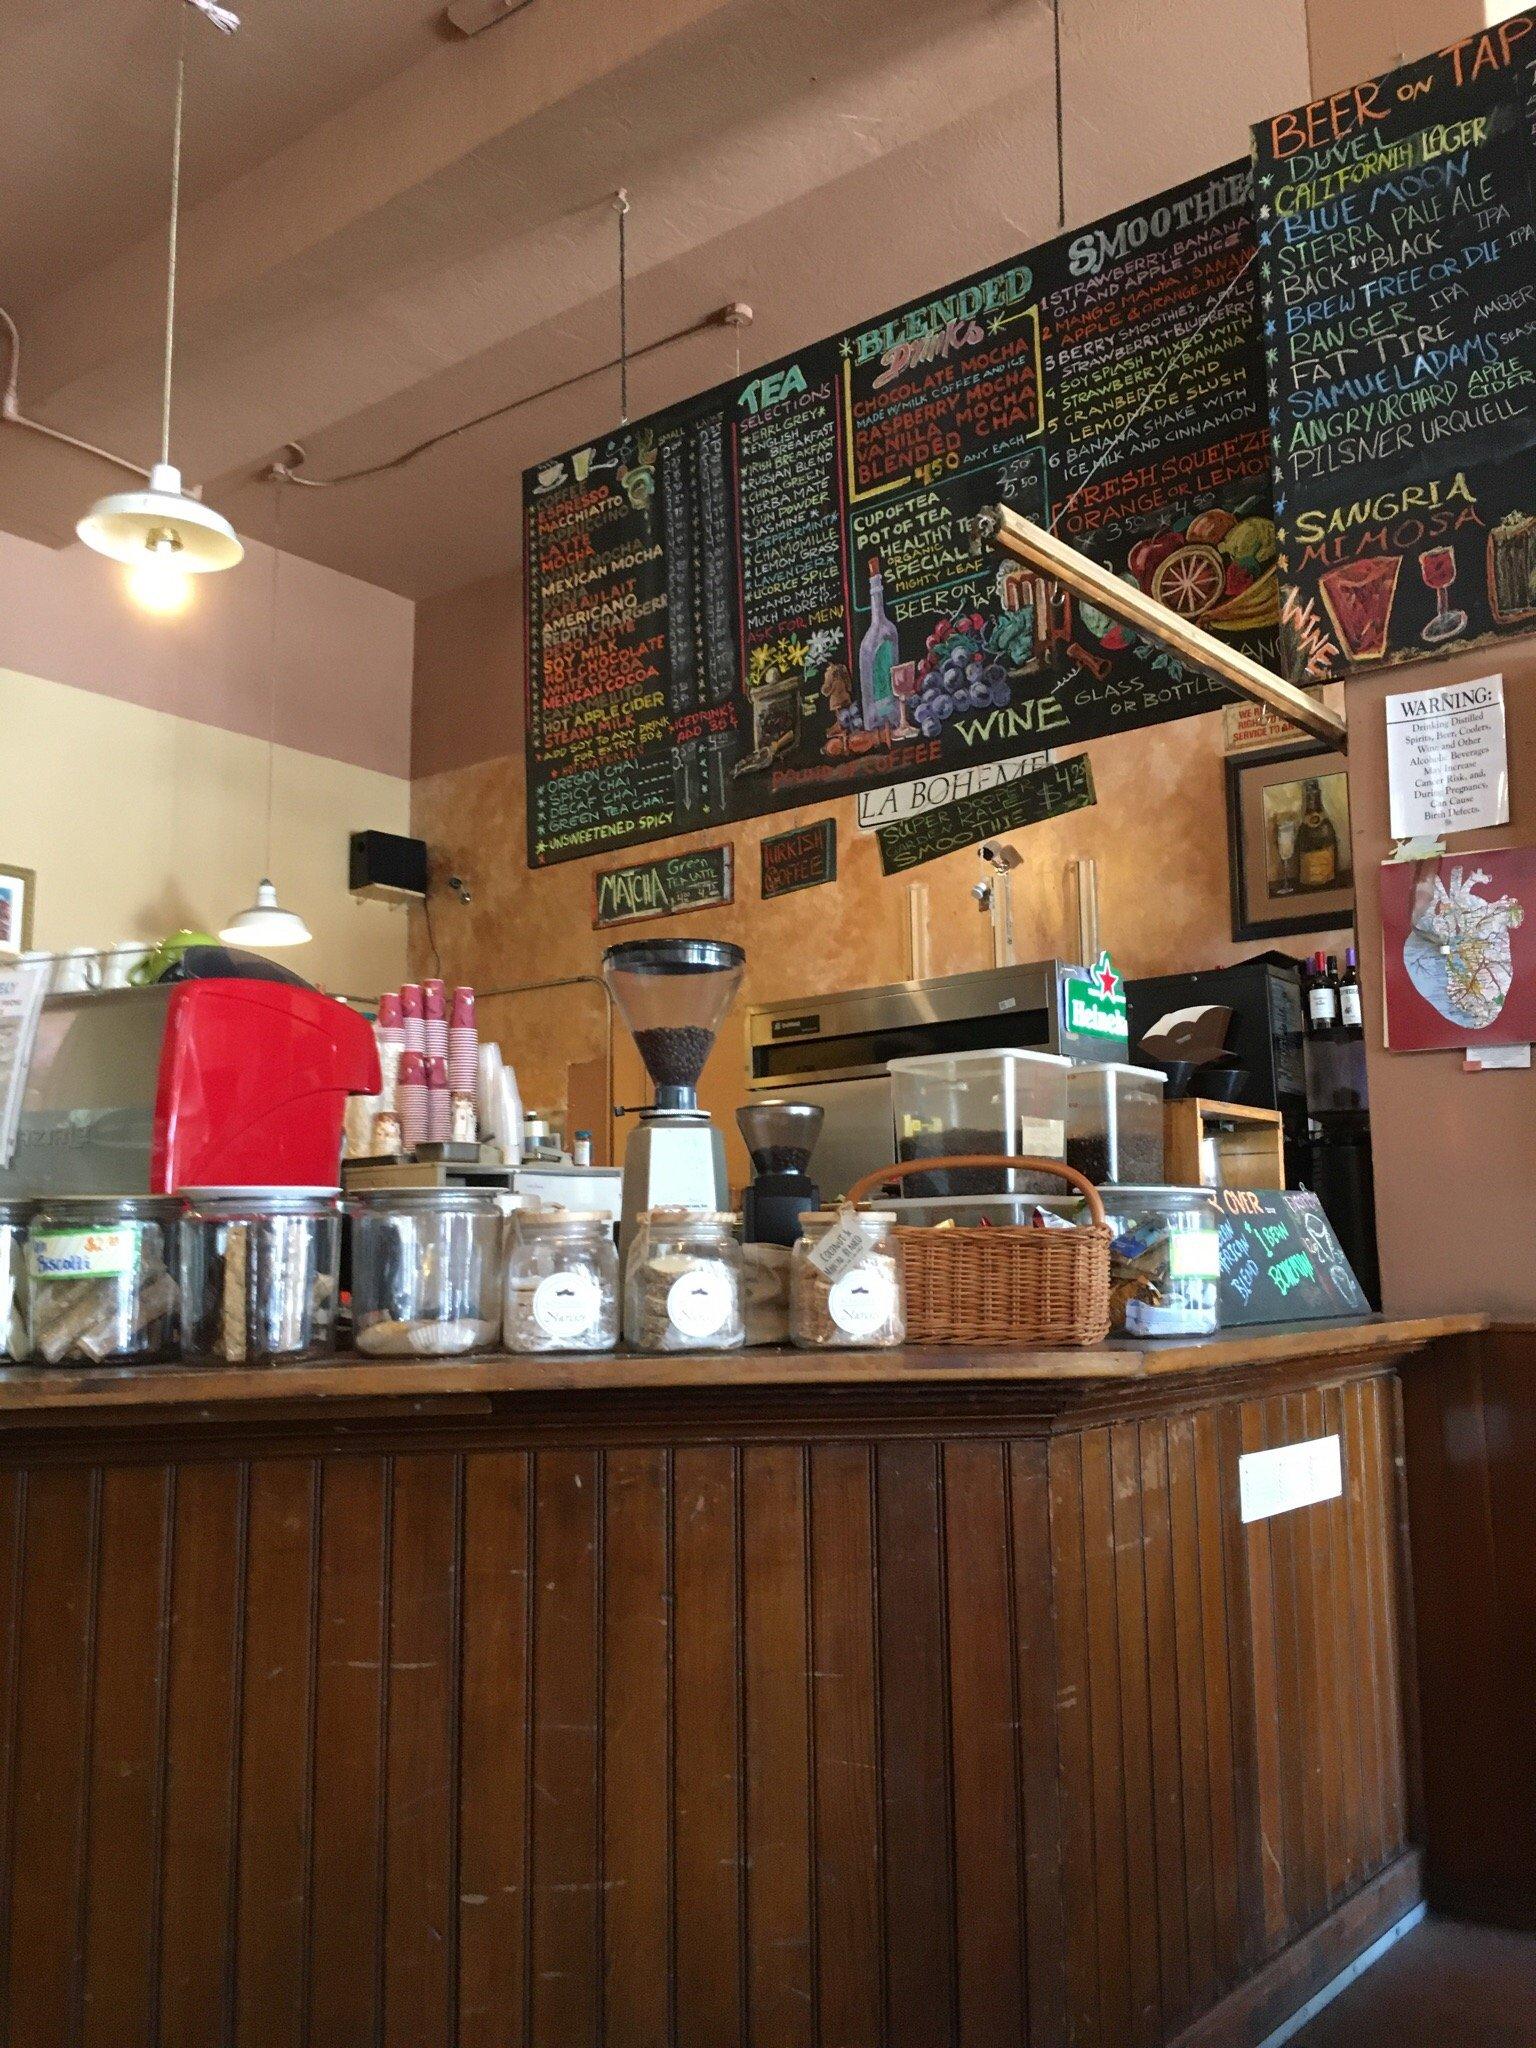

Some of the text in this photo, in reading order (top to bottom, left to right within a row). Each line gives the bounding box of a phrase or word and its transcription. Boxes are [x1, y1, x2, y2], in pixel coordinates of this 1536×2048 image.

[1271, 17, 1533, 159] BEER TAP
[1275, 116, 1488, 217] CALIFORNIA LAGER
[1284, 126, 1402, 183] DUVEL
[1283, 150, 1469, 243] BLUE MOON
[1279, 222, 1384, 276] SIERRA
[1391, 196, 1447, 235] PALE
[1452, 172, 1498, 216] ALE
[1084, 232, 1240, 306] AND APPLE JUICE
[1279, 229, 1443, 305] BACK BLACK
[1285, 238, 1501, 334] BREW FREE OR DIE
[855, 265, 1034, 366] BLENDED
[1056, 303, 1116, 333] MANGO
[1059, 280, 1255, 366] BERRY APPLE
[1060, 290, 1199, 347] APPLE ORANGE
[1290, 281, 1469, 362] RANGER IPA
[1060, 316, 1253, 394] SOY SPLASH MIXED WITH
[1289, 348, 1359, 390] FAT
[1366, 316, 1456, 365] TIRE
[737, 364, 808, 414] TEA
[853, 337, 1029, 419] CHOCOLATE MOCHA
[856, 356, 1026, 429] MADE COFFEE AND ICE
[1064, 361, 1220, 426] CRANBERRY AND
[1287, 364, 1424, 419] SAMUEL
[1414, 331, 1499, 380] ADAMS
[1467, 369, 1536, 400] CIDER
[740, 382, 831, 433] SELECTIONS
[856, 365, 1035, 444] RASPBERRY MOCHA
[856, 385, 1035, 462] VANILLA MOCHA
[1070, 367, 1247, 444] LEMONADE SLUSH
[1289, 356, 1525, 452] ANGRY ORCHARD APPLE
[751, 408, 818, 443] EARL GREY
[751, 428, 799, 454] ENGLISH
[769, 421, 834, 458] BREAKFAST
[859, 402, 1036, 484] BLENDED CHAI
[1064, 402, 1257, 481] ICE MILK AND CINNAMON
[1066, 387, 1247, 464] BANANA SHAKE WITH
[1287, 398, 1529, 481] PILSNER URQUELL
[774, 435, 835, 469] BREAKFAST
[963, 435, 1025, 464] ANY EACH
[749, 452, 834, 490] RUSSIAN BLEND
[782, 467, 825, 489] GREEN
[1065, 462, 1163, 514] FRESH
[538, 495, 623, 535] MACCHIATTO
[750, 475, 831, 515] YERBA MATE
[778, 491, 830, 517] POWDER
[1066, 489, 1166, 534] ORANGE
[1168, 484, 1193, 498] OR
[1294, 471, 1477, 544] SANGRIA
[747, 511, 806, 541] JASMINE
[756, 515, 829, 550] PEPPERMINT
[915, 506, 952, 527] TEA
[540, 533, 590, 562] LATTE
[754, 528, 839, 564] CHAMOMILLE
[880, 521, 953, 558] HEALTHY
[1297, 505, 1486, 572] MIMOSA
[541, 566, 607, 598] MEXICAN
[611, 543, 663, 572] MOCHA
[755, 541, 839, 577] LEMON GRASS
[755, 557, 825, 588] LAVENDER
[883, 547, 969, 584] SPECIAL
[895, 558, 984, 593] MIGHTY LEAF
[753, 565, 840, 600] LICORICE SPICE
[895, 582, 976, 622] BEER ON
[542, 593, 637, 633] AMERICANO
[1279, 584, 1341, 677] WINE
[621, 691, 664, 715] CIDER
[1074, 676, 1145, 706] GLASS
[1110, 676, 1224, 716] OR BOTTLE
[1400, 686, 1492, 718] WARNING:
[953, 695, 1070, 748] WINE
[1233, 726, 1268, 741] SERVICE
[1451, 711, 1484, 726] Distilled
[1451, 747, 1490, 761] Beverages
[1457, 736, 1482, 748] Other
[548, 769, 600, 794] OREGON
[604, 760, 640, 778] CHAI
[550, 777, 630, 806] SPICY CHAI
[550, 789, 638, 819] DECAF CHAI
[861, 787, 898, 819] LA
[959, 797, 1027, 827] KALE
[548, 811, 674, 851] UNSWEETENED SPICY
[882, 810, 950, 844] SUPER
[600, 867, 669, 920] MATCHA
